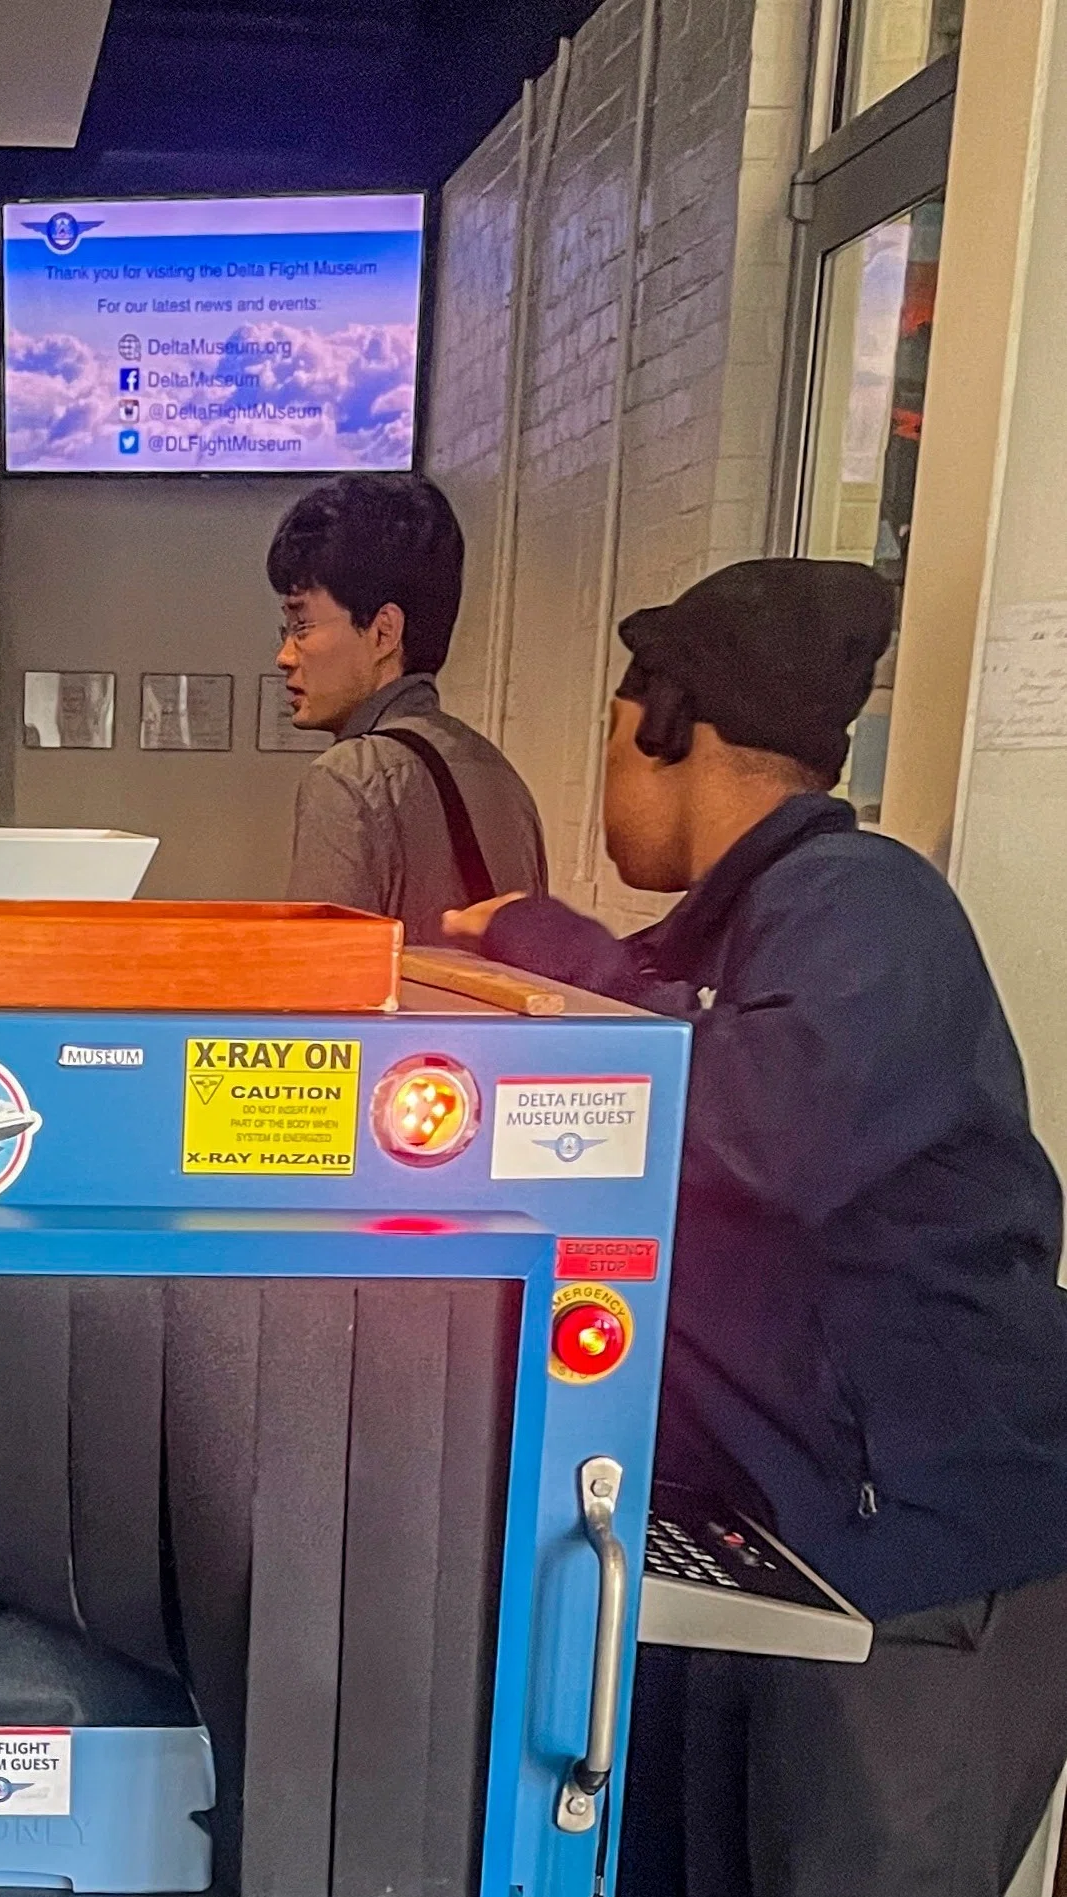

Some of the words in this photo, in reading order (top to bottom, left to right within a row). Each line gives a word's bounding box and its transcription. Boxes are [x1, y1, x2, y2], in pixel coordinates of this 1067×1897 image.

[45, 265, 88, 280] Thank
[93, 267, 118, 283] you
[123, 264, 142, 279] for
[147, 263, 195, 282] visiting
[200, 263, 222, 278] the
[227, 262, 264, 277] Delta
[269, 261, 310, 280] Flight
[314, 260, 377, 276] Museum
[97, 298, 121, 313] For
[125, 301, 148, 313] our
[152, 297, 191, 313] latest
[195, 300, 233, 312] news
[237, 297, 264, 312] and
[268, 297, 322, 312] events:
[148, 338, 292, 358] DeltaMuseum.org
[148, 371, 260, 388] DeltaMuseum
[149, 404, 322, 423] @DeltaFlightMuseum
[148, 435, 302, 456] @DLFlightMuseum
[67, 1049, 140, 1064] MUSEUM
[194, 1042, 293, 1069] X-RAY
[304, 1043, 352, 1069] ON
[231, 1086, 341, 1099] CAUTION
[518, 1093, 566, 1107] DELTA
[571, 1092, 627, 1107] FLIGHT
[242, 1105, 256, 1114] DO
[258, 1105, 275, 1114] NOT
[310, 1106, 328, 1115] ANY
[230, 1119, 252, 1128] PART
[287, 1119, 310, 1128] BODY
[312, 1120, 339, 1128] WHEN
[506, 1111, 579, 1126] MUSEUM
[583, 1110, 635, 1125] GUEST
[236, 1133, 271, 1142] SYSTEM
[187, 1152, 252, 1164] X-RAY
[260, 1153, 351, 1165] HAZARD
[565, 1244, 654, 1256] EMERGENCY
[589, 1260, 626, 1271] STOP
[553, 1287, 625, 1316] MERGENCY
[11, 1758, 59, 1770] GUEST
